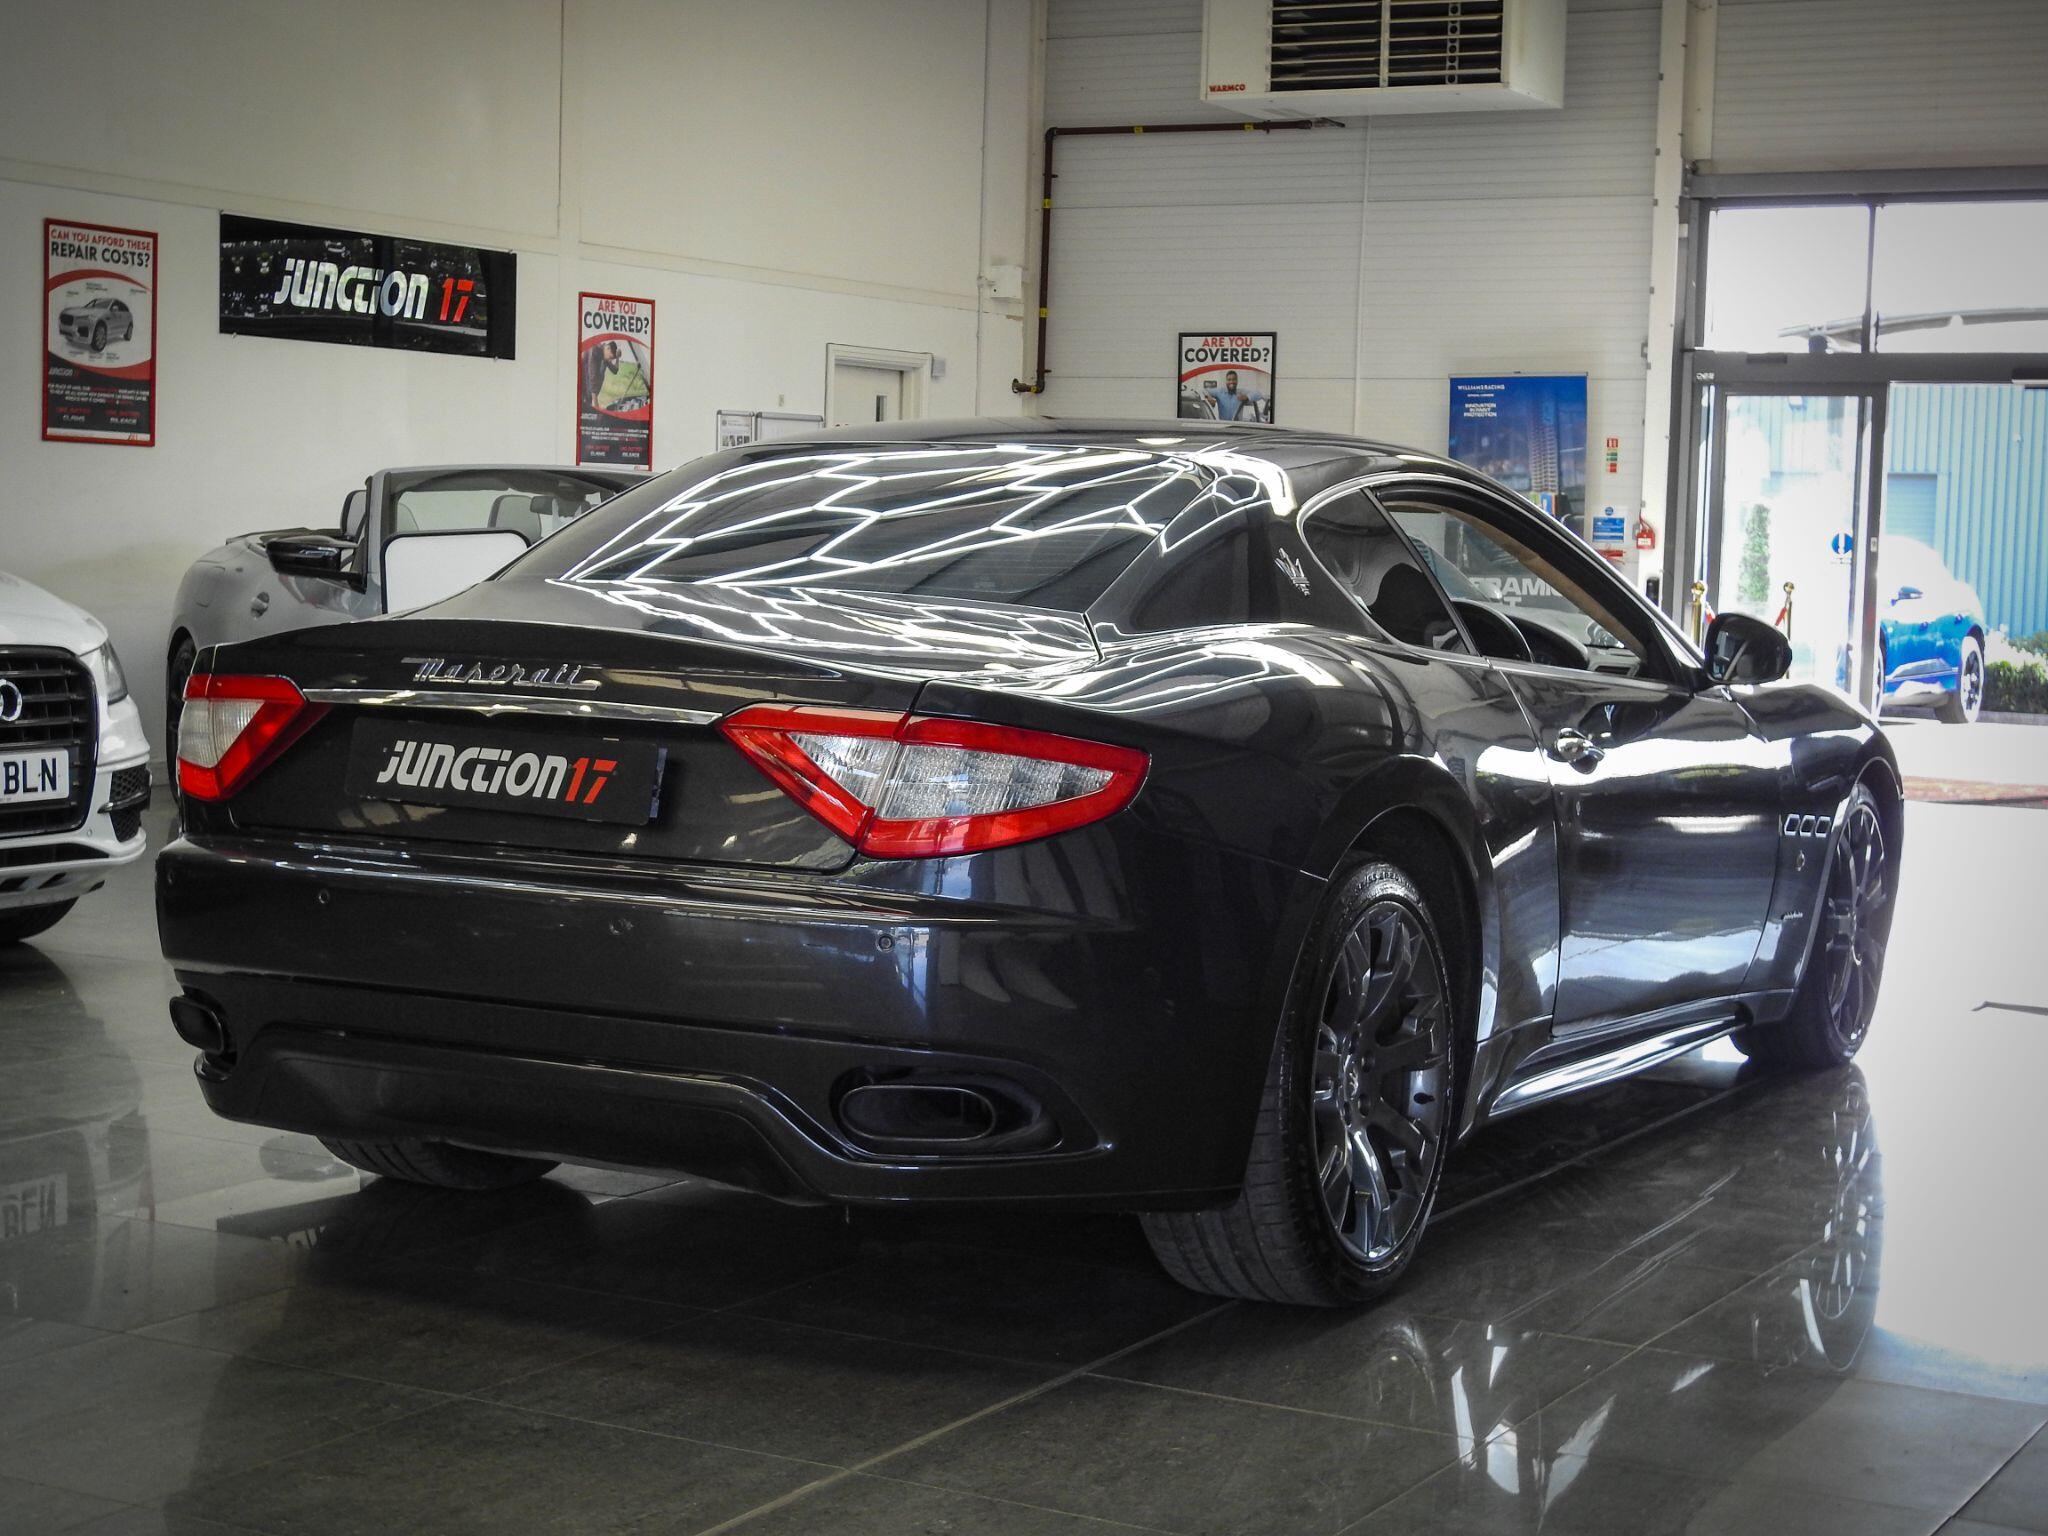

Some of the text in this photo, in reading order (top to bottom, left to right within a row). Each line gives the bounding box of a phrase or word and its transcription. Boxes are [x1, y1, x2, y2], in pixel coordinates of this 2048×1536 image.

[1209, 84, 1246, 92] WARMCO
[50, 228, 152, 251] CAN YOU AFFORD THESE
[50, 241, 151, 268] REPAIR COSTS?
[438, 276, 475, 324] 17
[598, 300, 637, 315] ARE YOU
[583, 310, 650, 335] COVERED?
[1202, 336, 1253, 348] ARE YOU
[1184, 347, 1270, 363] COVERED?
[401, 657, 603, 692] Maserati
[3, 757, 57, 795] BLN
